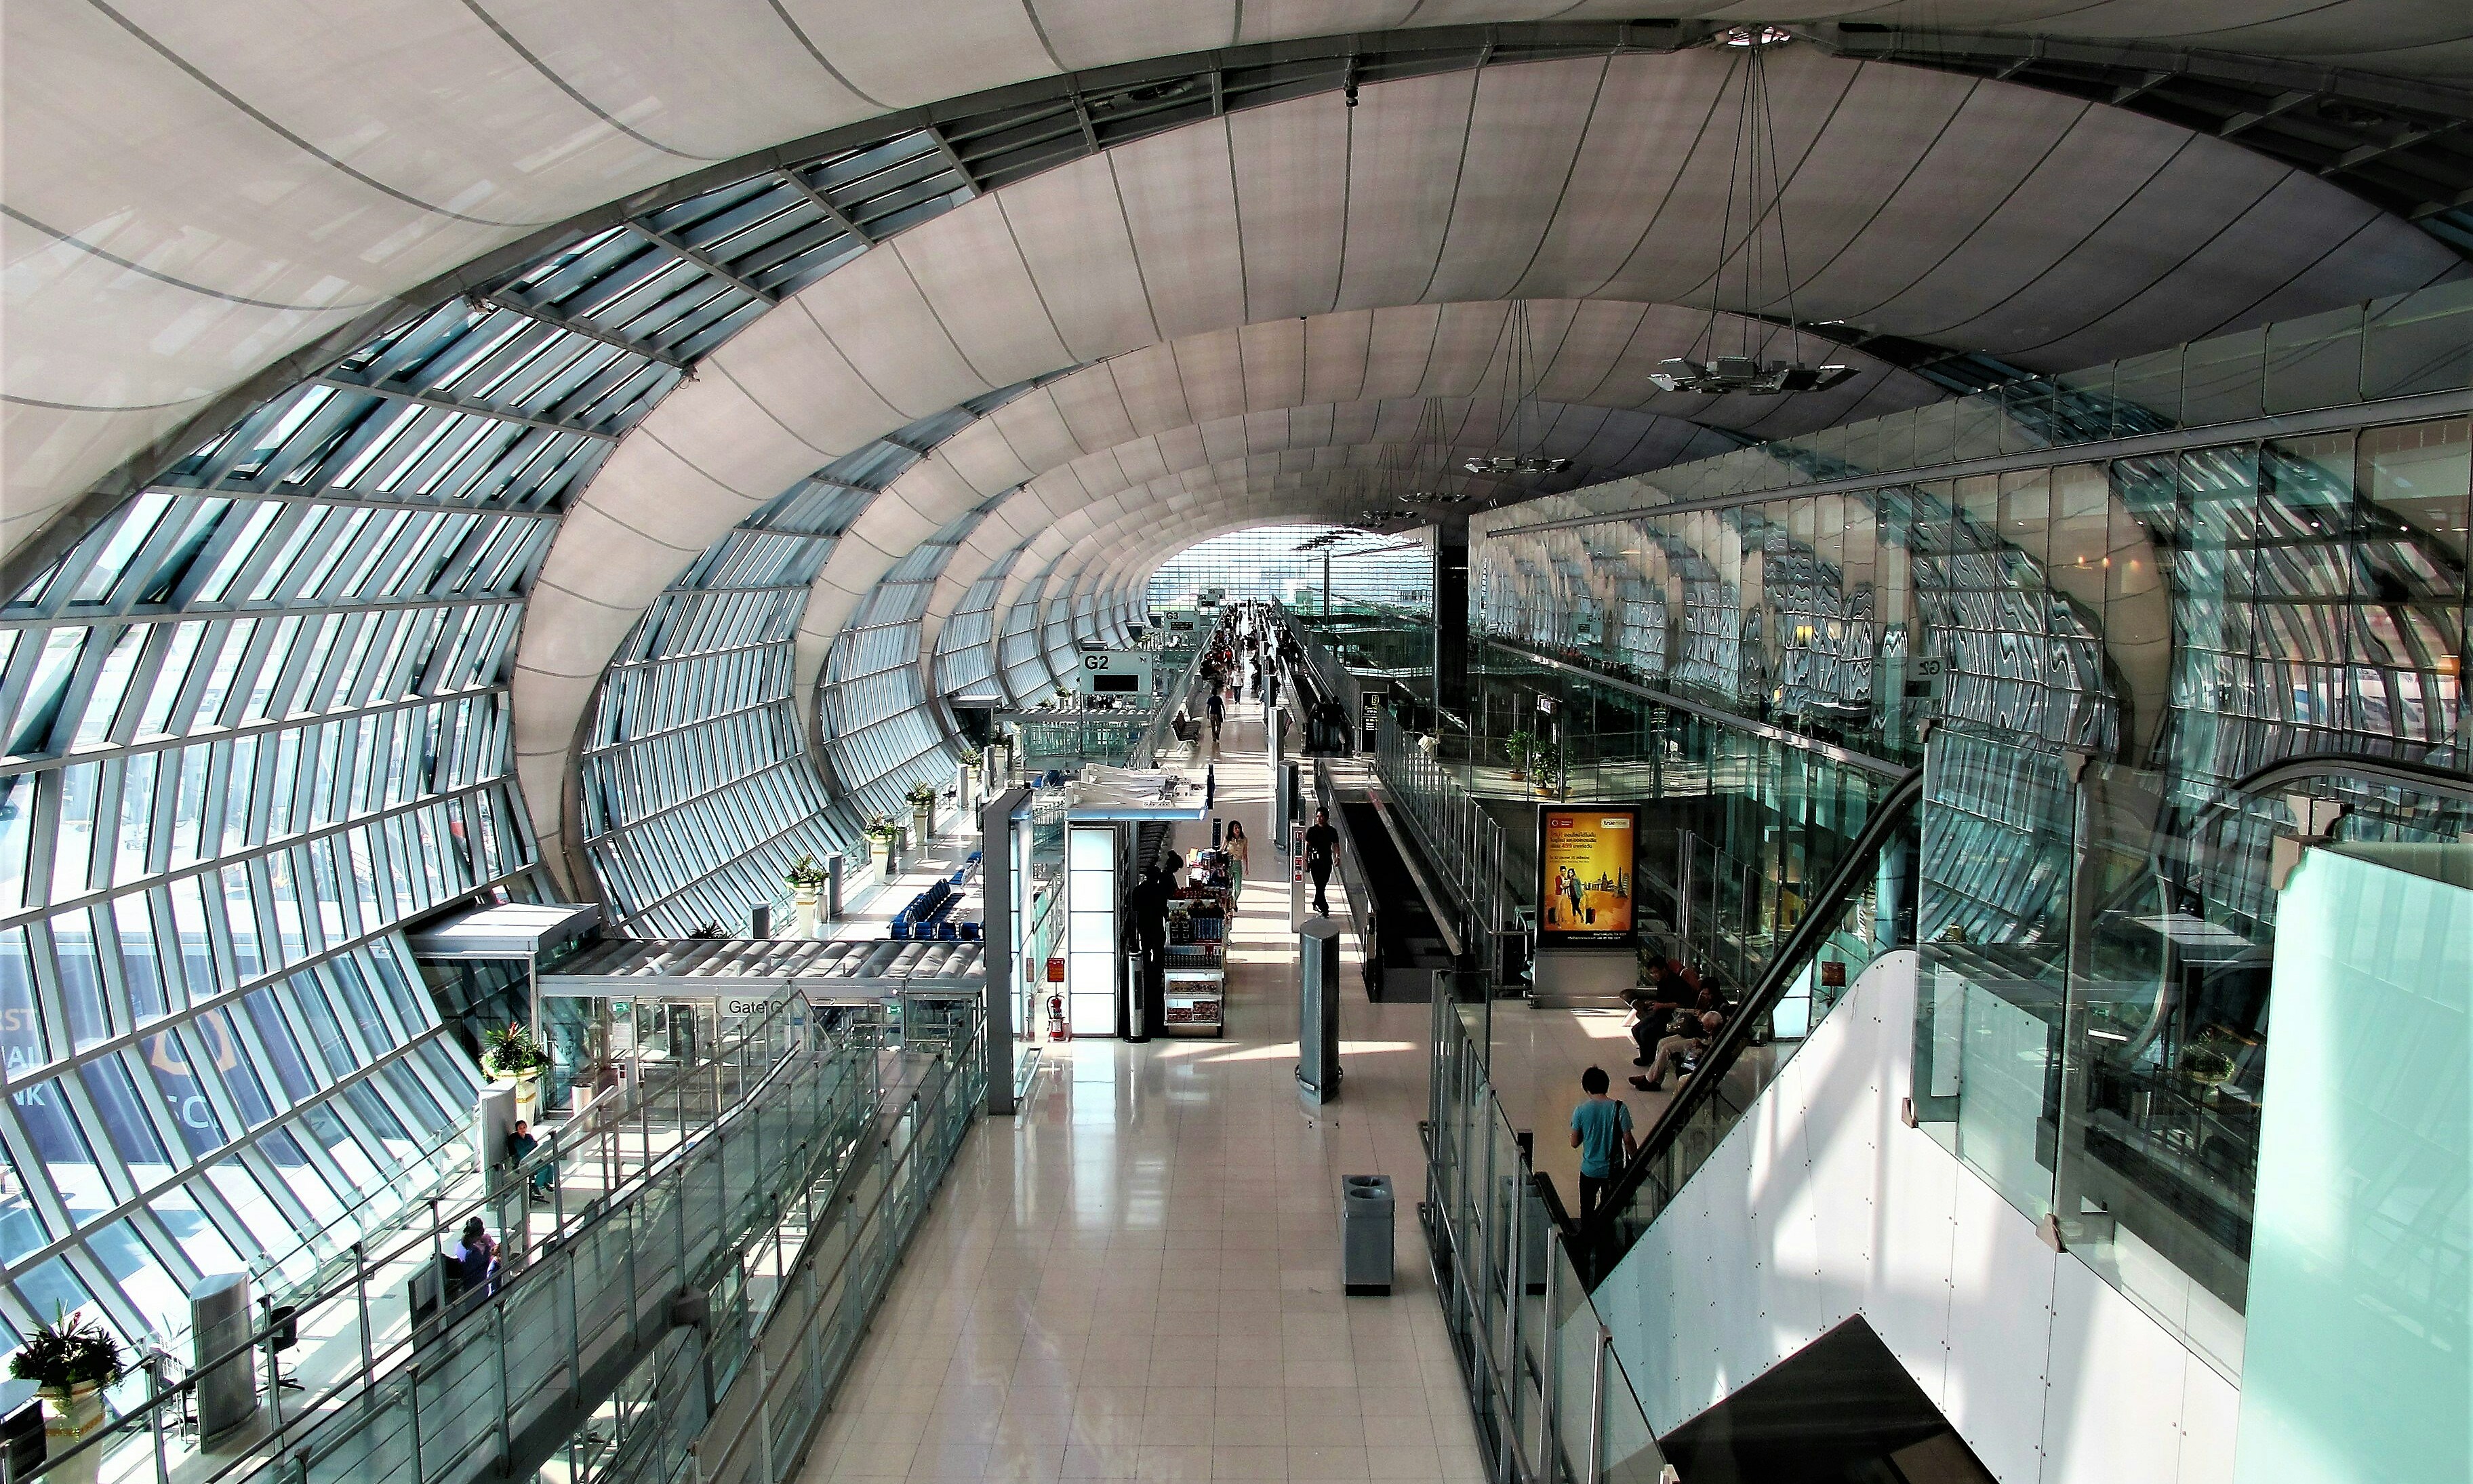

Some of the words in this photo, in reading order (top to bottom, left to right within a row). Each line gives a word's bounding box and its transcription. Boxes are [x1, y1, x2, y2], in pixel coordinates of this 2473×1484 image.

[1166, 611, 1180, 620] G3
[1085, 655, 1109, 670] G2
[729, 1000, 765, 1014] Gate
[0, 1008, 35, 1031] ST
[2, 1046, 34, 1069] AI
